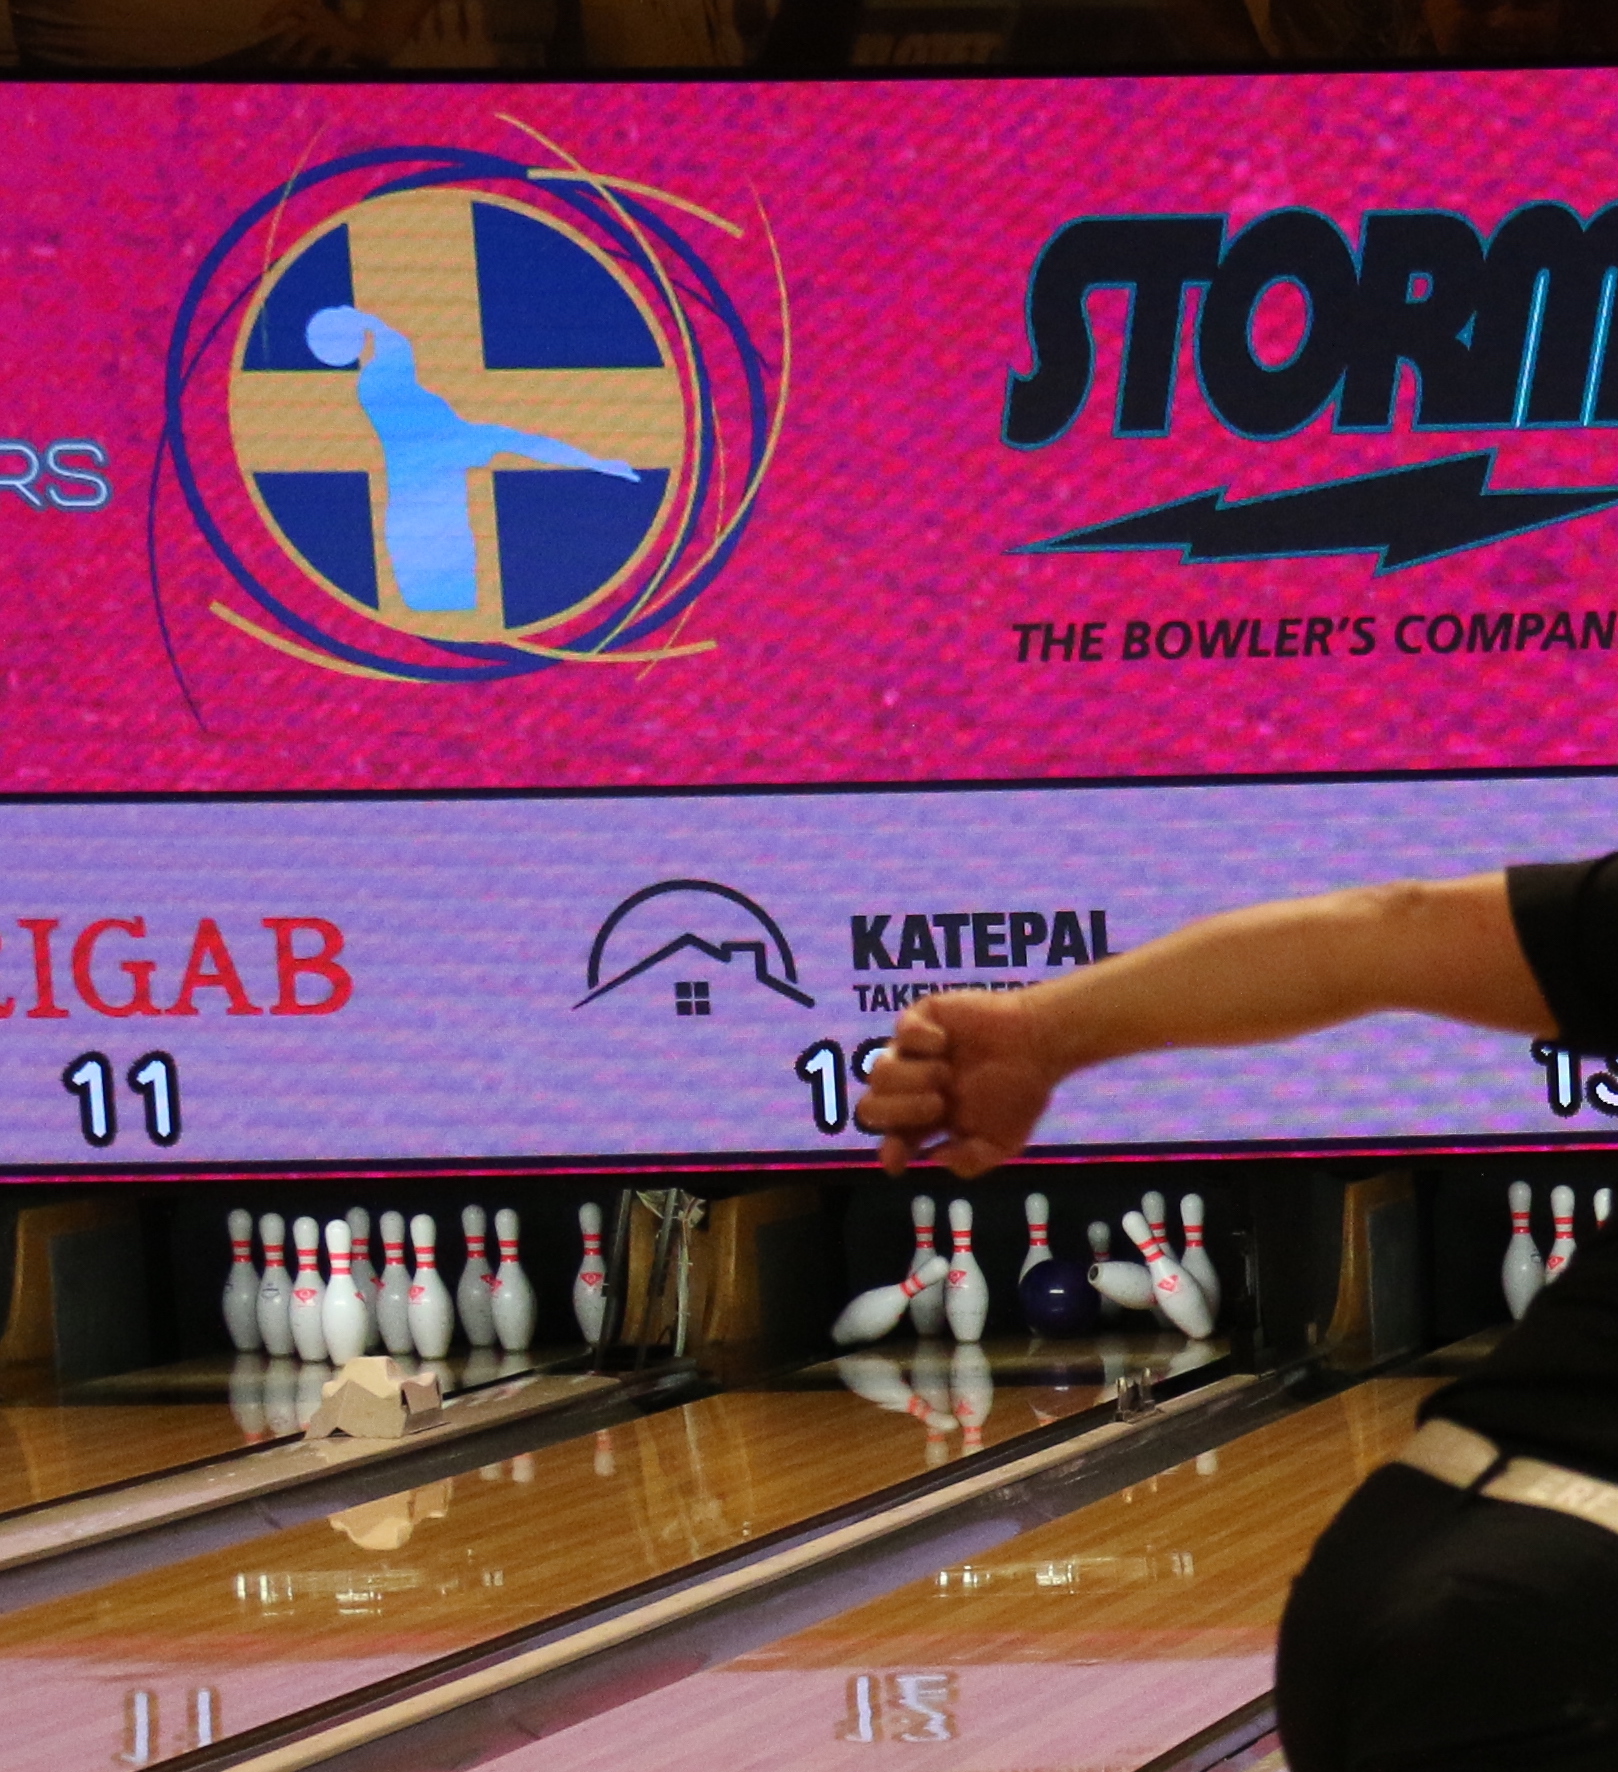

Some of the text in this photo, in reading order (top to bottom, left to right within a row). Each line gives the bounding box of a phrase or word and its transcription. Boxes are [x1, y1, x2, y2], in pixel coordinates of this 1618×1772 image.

[1012, 620, 1107, 663] THE
[1121, 616, 1378, 662] BOWLER'S
[852, 909, 1119, 971] KATEPAL
[64, 1051, 181, 1146] 11
